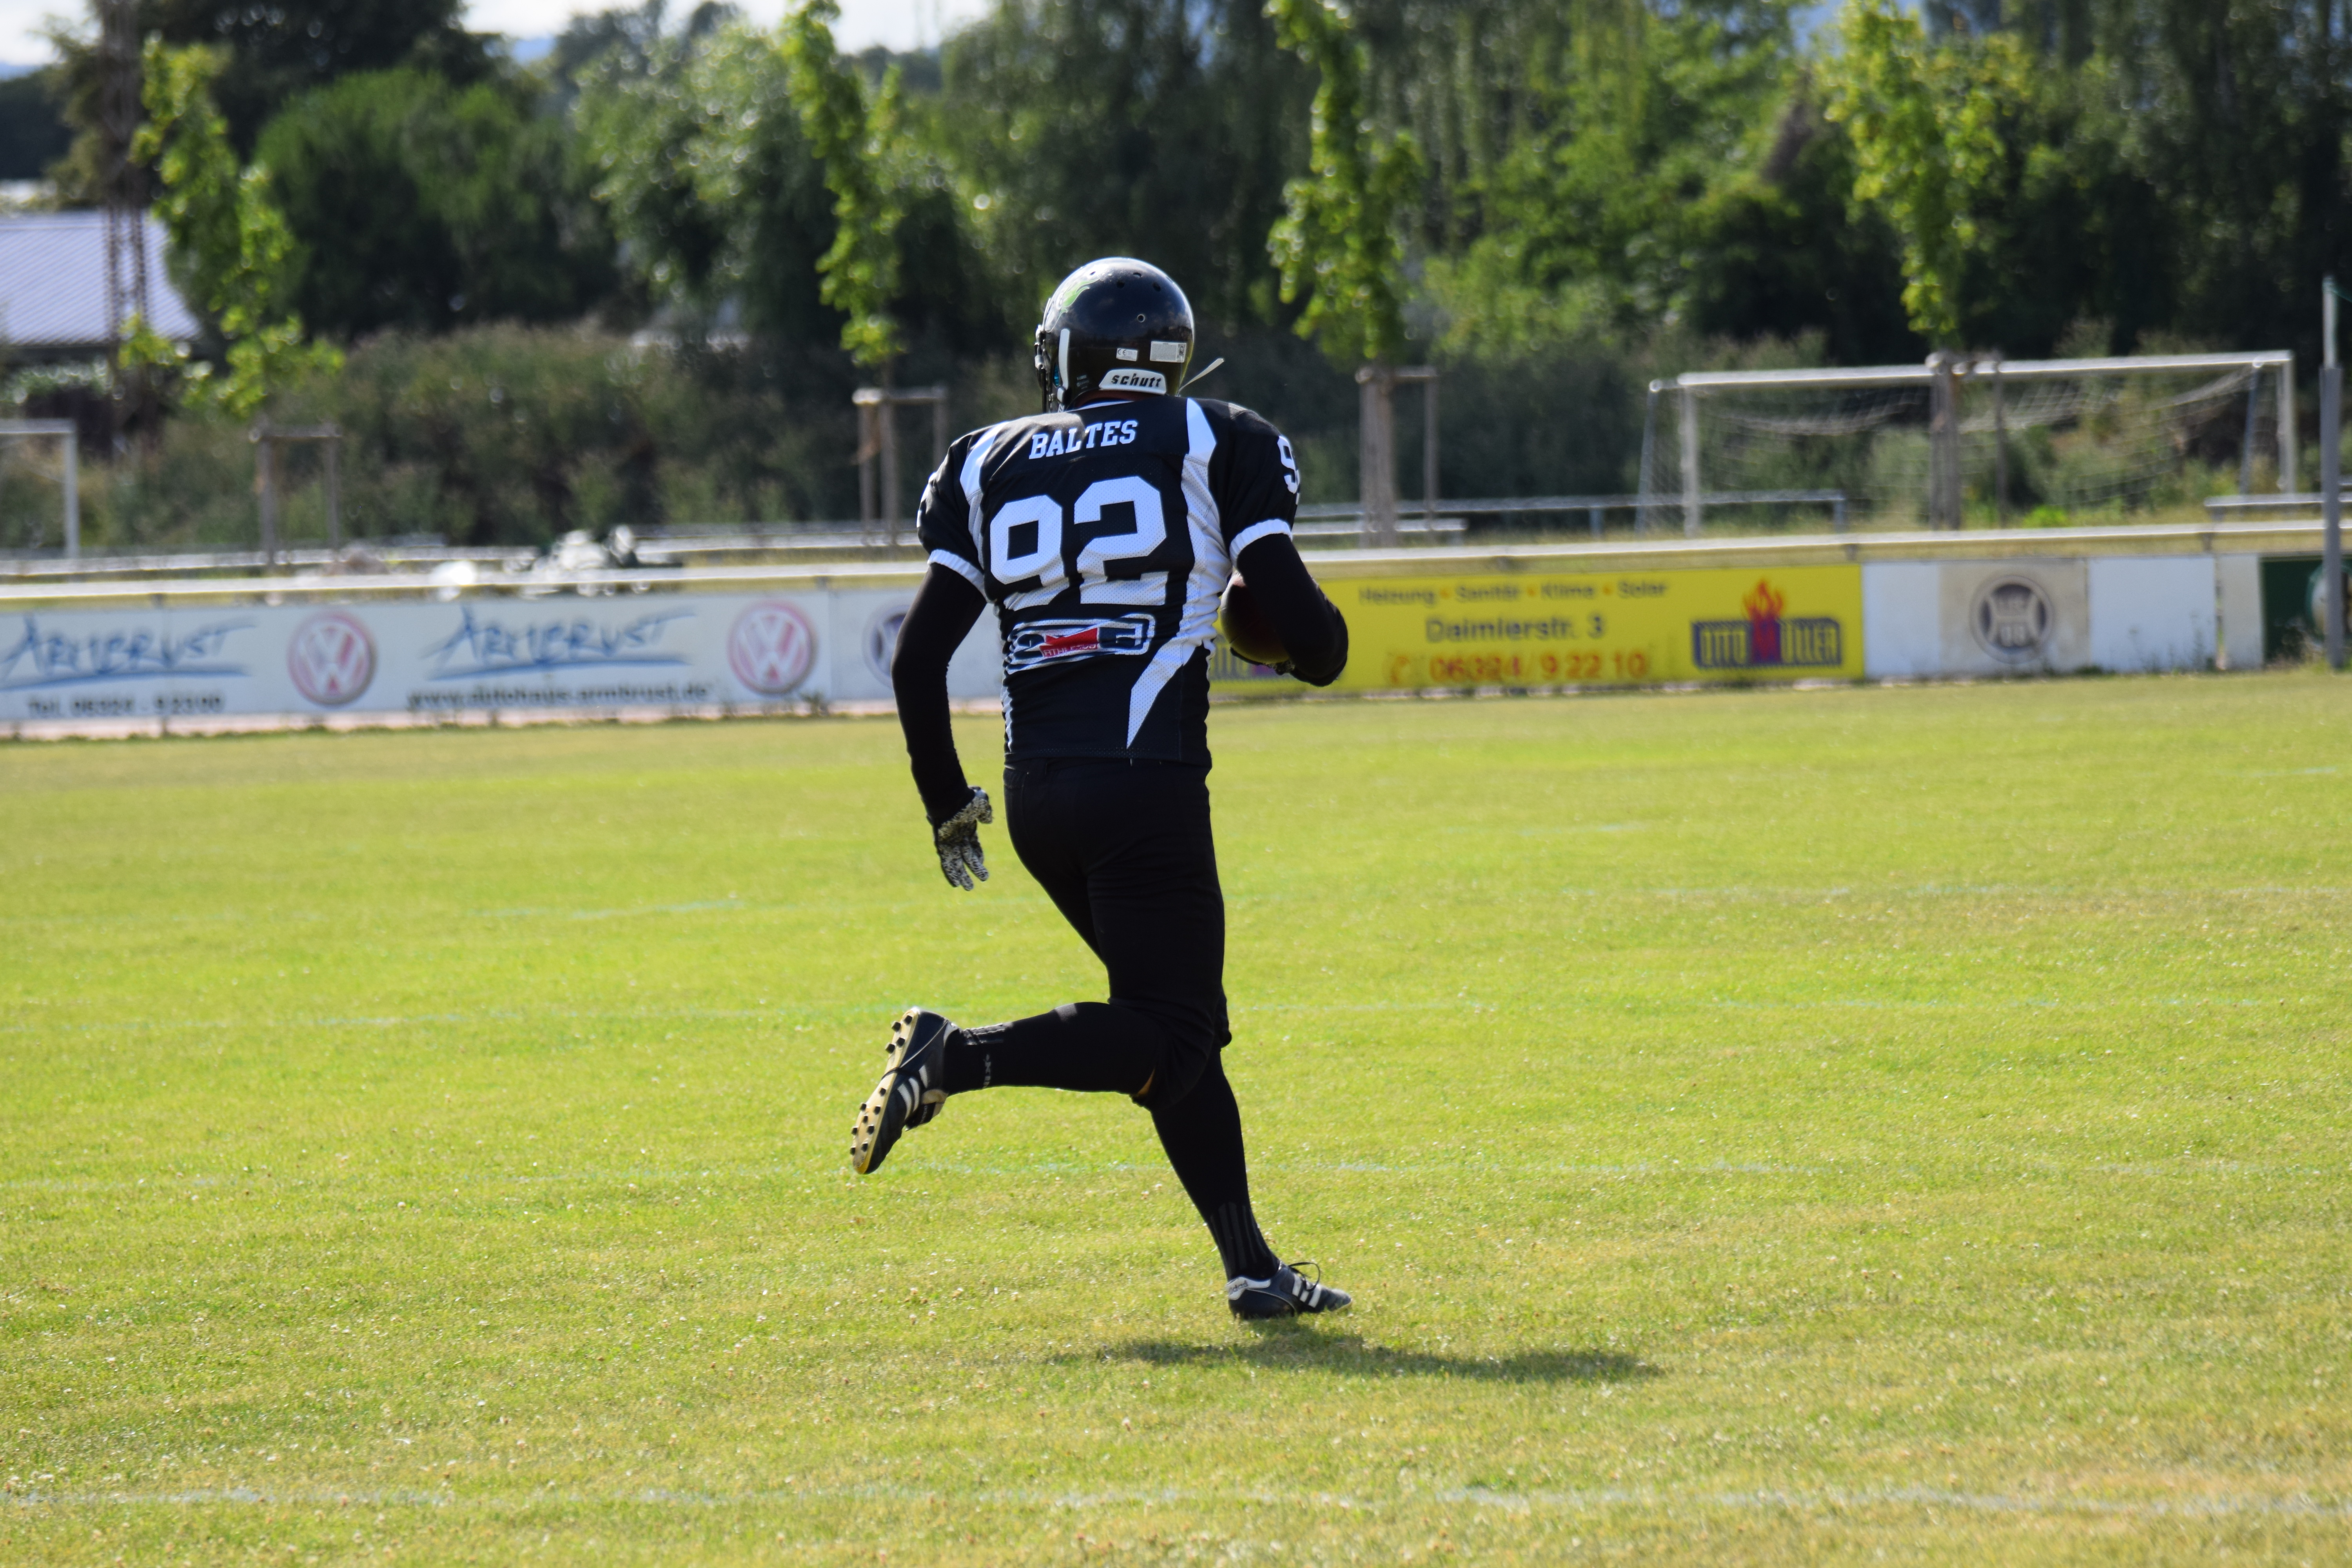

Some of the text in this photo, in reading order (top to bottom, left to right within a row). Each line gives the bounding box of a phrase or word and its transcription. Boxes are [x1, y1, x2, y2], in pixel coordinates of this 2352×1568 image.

[1029, 420, 1138, 459] BALTES
[990, 476, 1169, 609] 92
[1359, 587, 1436, 608] Heizung
[1541, 581, 1594, 599] Klima
[1617, 580, 1666, 598] Solar
[1426, 612, 1606, 643] Daimlerstr. 3
